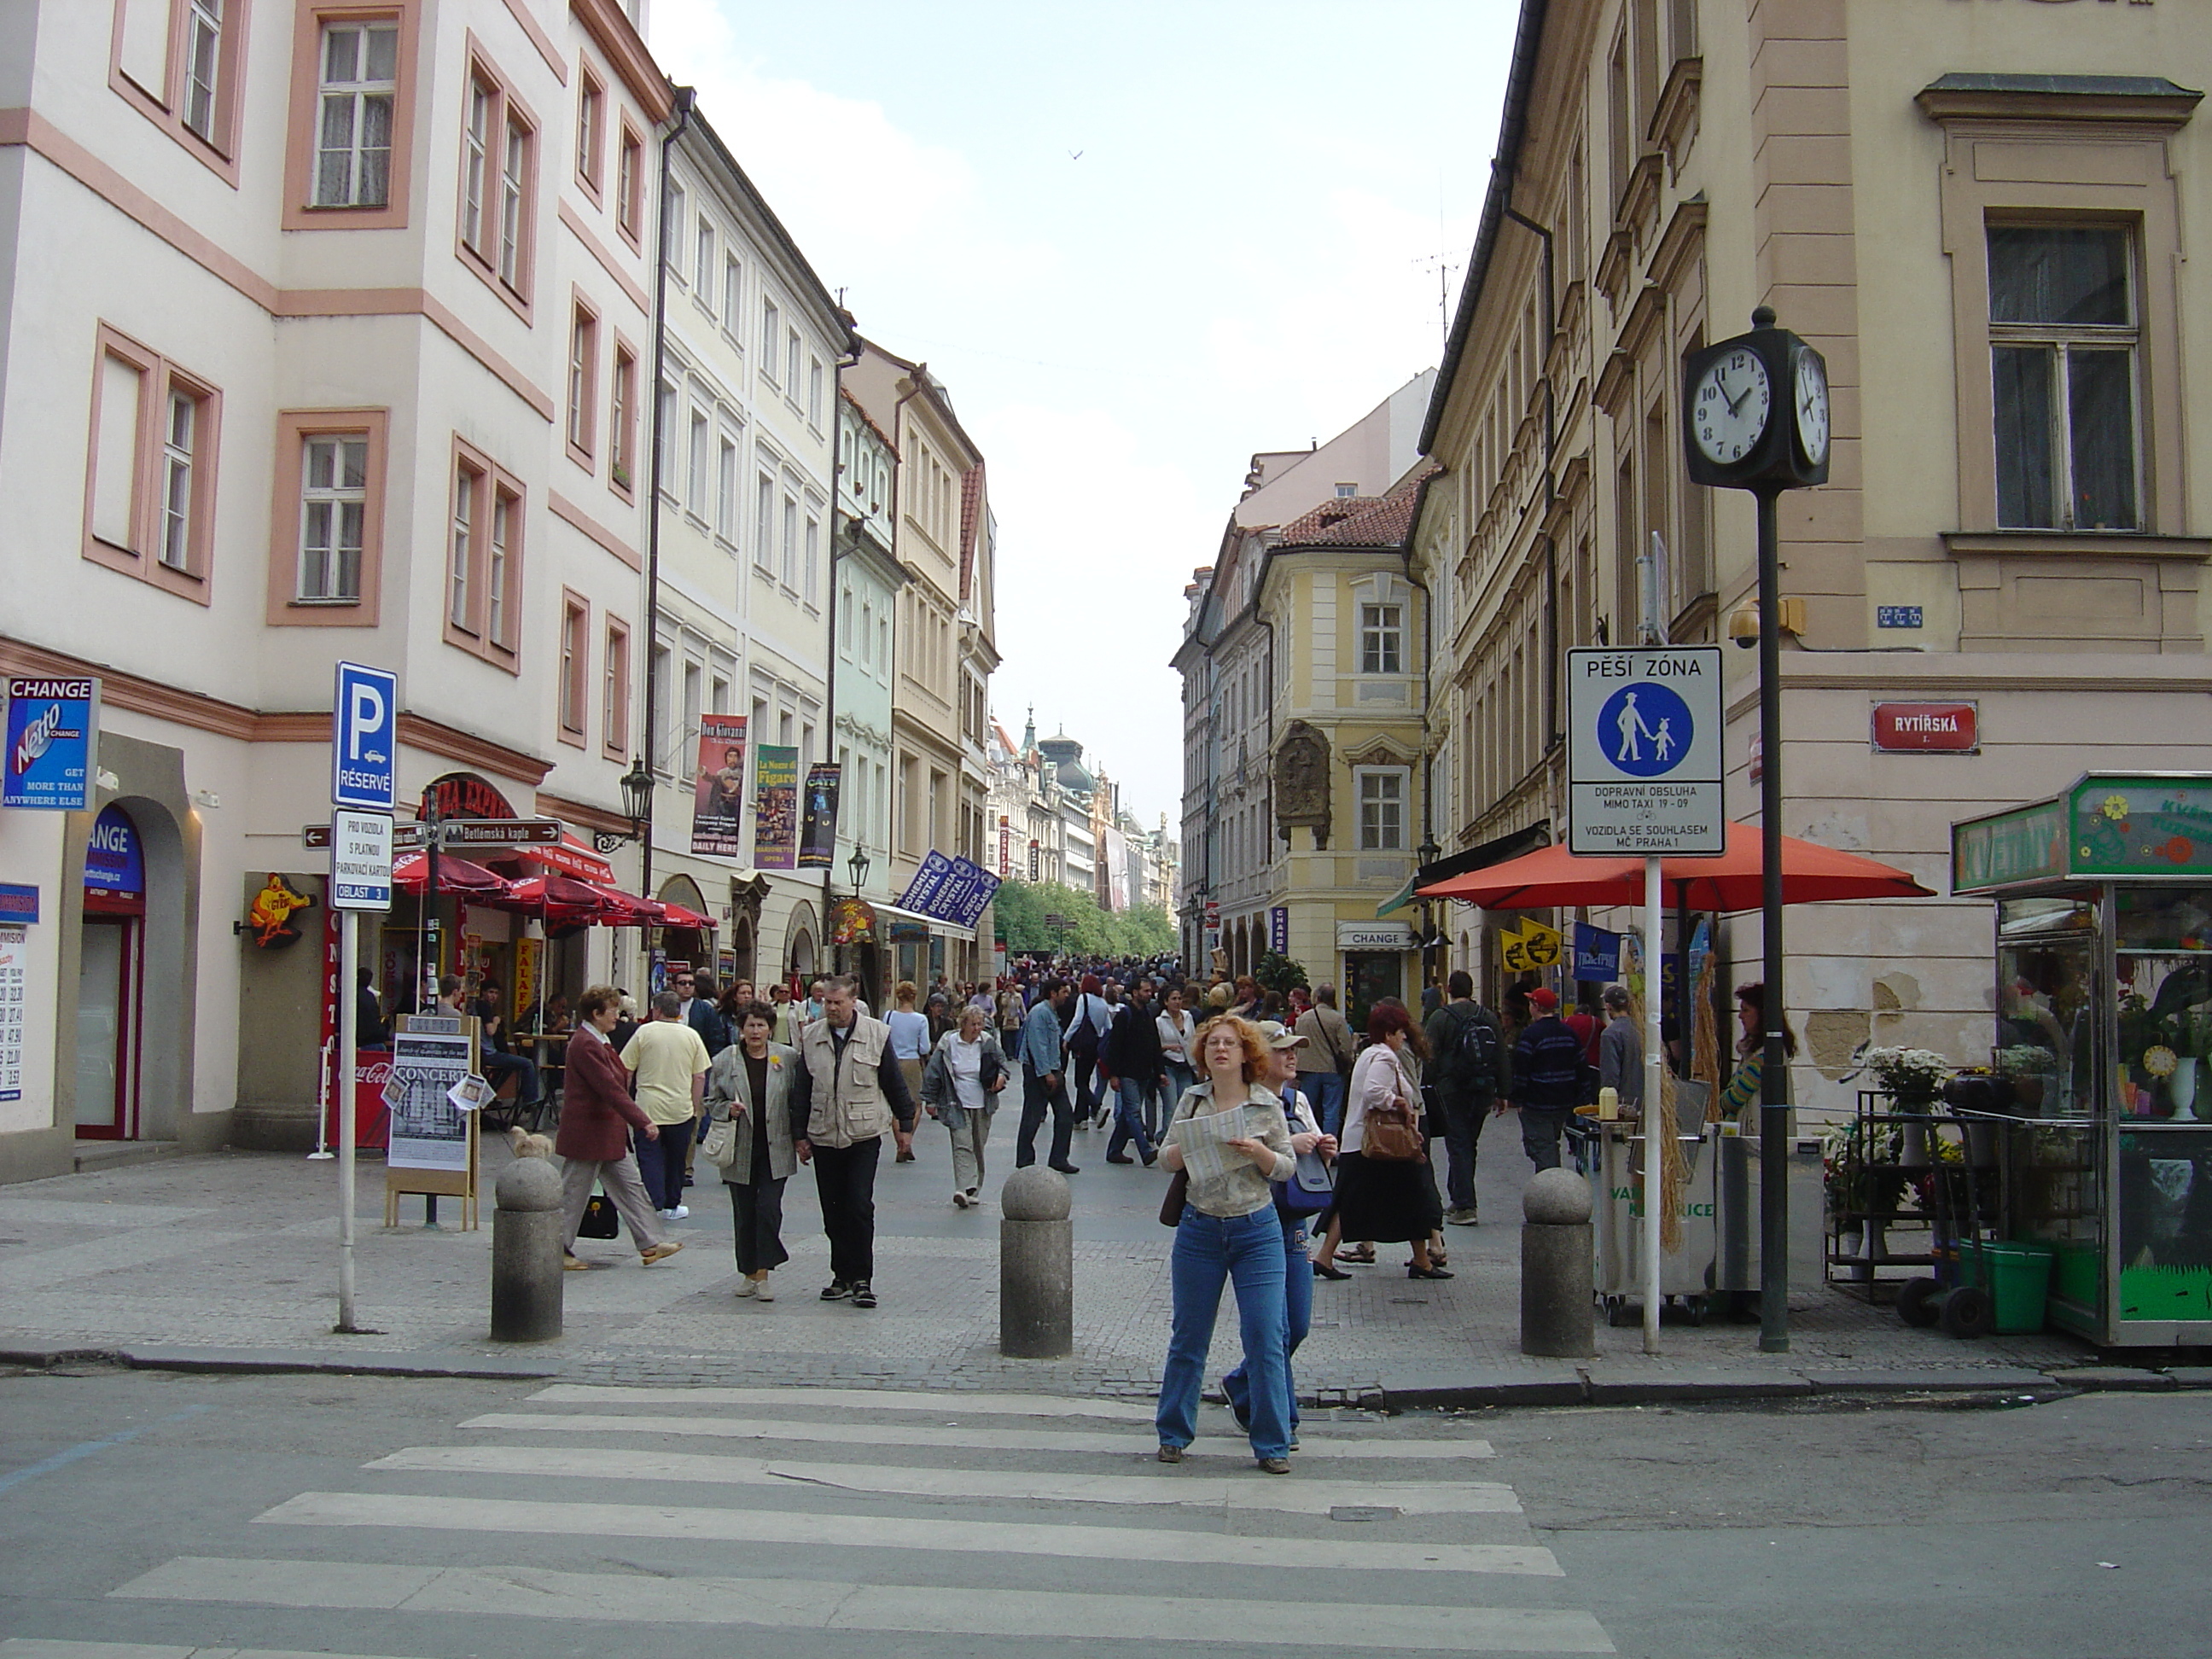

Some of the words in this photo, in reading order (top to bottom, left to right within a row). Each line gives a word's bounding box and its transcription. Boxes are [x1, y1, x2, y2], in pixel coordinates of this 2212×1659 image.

[1730, 354, 1744, 370] 12
[1750, 358, 1755, 372] 1
[1714, 369, 1726, 382] 11
[1758, 371, 1765, 386] 2
[1701, 387, 1717, 402] 10
[1761, 390, 1768, 405] 3
[1815, 386, 1821, 399] 2
[1697, 407, 1707, 422] 9
[1757, 414, 1764, 428] 4
[1819, 409, 1825, 422] 3
[1703, 427, 1713, 440] 8
[1749, 434, 1756, 448] 5
[1716, 441, 1725, 456] 7
[1733, 445, 1742, 459] 6
[1587, 655, 1633, 678] PĚŠÍ
[1646, 655, 1702, 677] ZÓNA
[11, 681, 90, 698] CHANGE
[350, 682, 384, 760] P
[1895, 714, 1958, 732] RYTÍŘSKÁ
[50, 730, 79, 738] CHANGE
[702, 722, 714, 736] Don
[716, 723, 747, 739] Giovanni
[17, 703, 60, 774] Netto
[65, 768, 84, 777] GET
[341, 768, 391, 792] RÉSERVÉ
[758, 771, 796, 786] Figaro
[26, 783, 55, 791] MORE
[57, 783, 84, 791] THAN
[807, 778, 836, 787] CATS
[1595, 785, 1645, 797] DOPRAVNÍ
[1650, 787, 1697, 796] OBSLUHA
[3, 796, 56, 805] ANYWHERE
[59, 797, 83, 806] ELSE
[1604, 800, 1629, 809] MIMO
[1632, 800, 1653, 808] TAXI
[1659, 799, 1668, 808] 19
[1678, 799, 1688, 808] 09
[347, 820, 359, 833] PRO
[360, 821, 384, 835] VOZIDLA
[464, 826, 505, 840] Betlémská
[508, 827, 529, 842] kaple
[1586, 826, 1628, 836] VOZIDLA
[1630, 826, 1642, 835] SE
[1646, 825, 1708, 835] SOUHLASEM
[89, 824, 128, 853] ANGE
[1616, 836, 1632, 847] MČ
[1636, 838, 1672, 847] PRAHA
[1674, 838, 1679, 847] 1
[349, 842, 354, 854] S
[354, 842, 381, 857] PLATNOU
[692, 841, 714, 851] DAILY
[717, 842, 737, 853] HERE
[336, 861, 368, 876] PARKOVACÍ
[368, 864, 390, 877] KARTOU
[338, 886, 369, 899] OBLAST
[376, 888, 381, 899] 3
[902, 868, 932, 910] BOHEMIA
[911, 874, 940, 911] CRYSTAL
[928, 872, 957, 912] BOHEMIA
[938, 879, 965, 914] CRYSTAL
[962, 893, 981, 916] CZECH
[965, 912, 977, 927] ART
[975, 888, 992, 912] GLASS
[1352, 934, 1399, 944] CHANGE
[519, 945, 530, 1013] FALAFE
[1346, 963, 1354, 1015] CHAN
[397, 1067, 468, 1082] CONCERT
